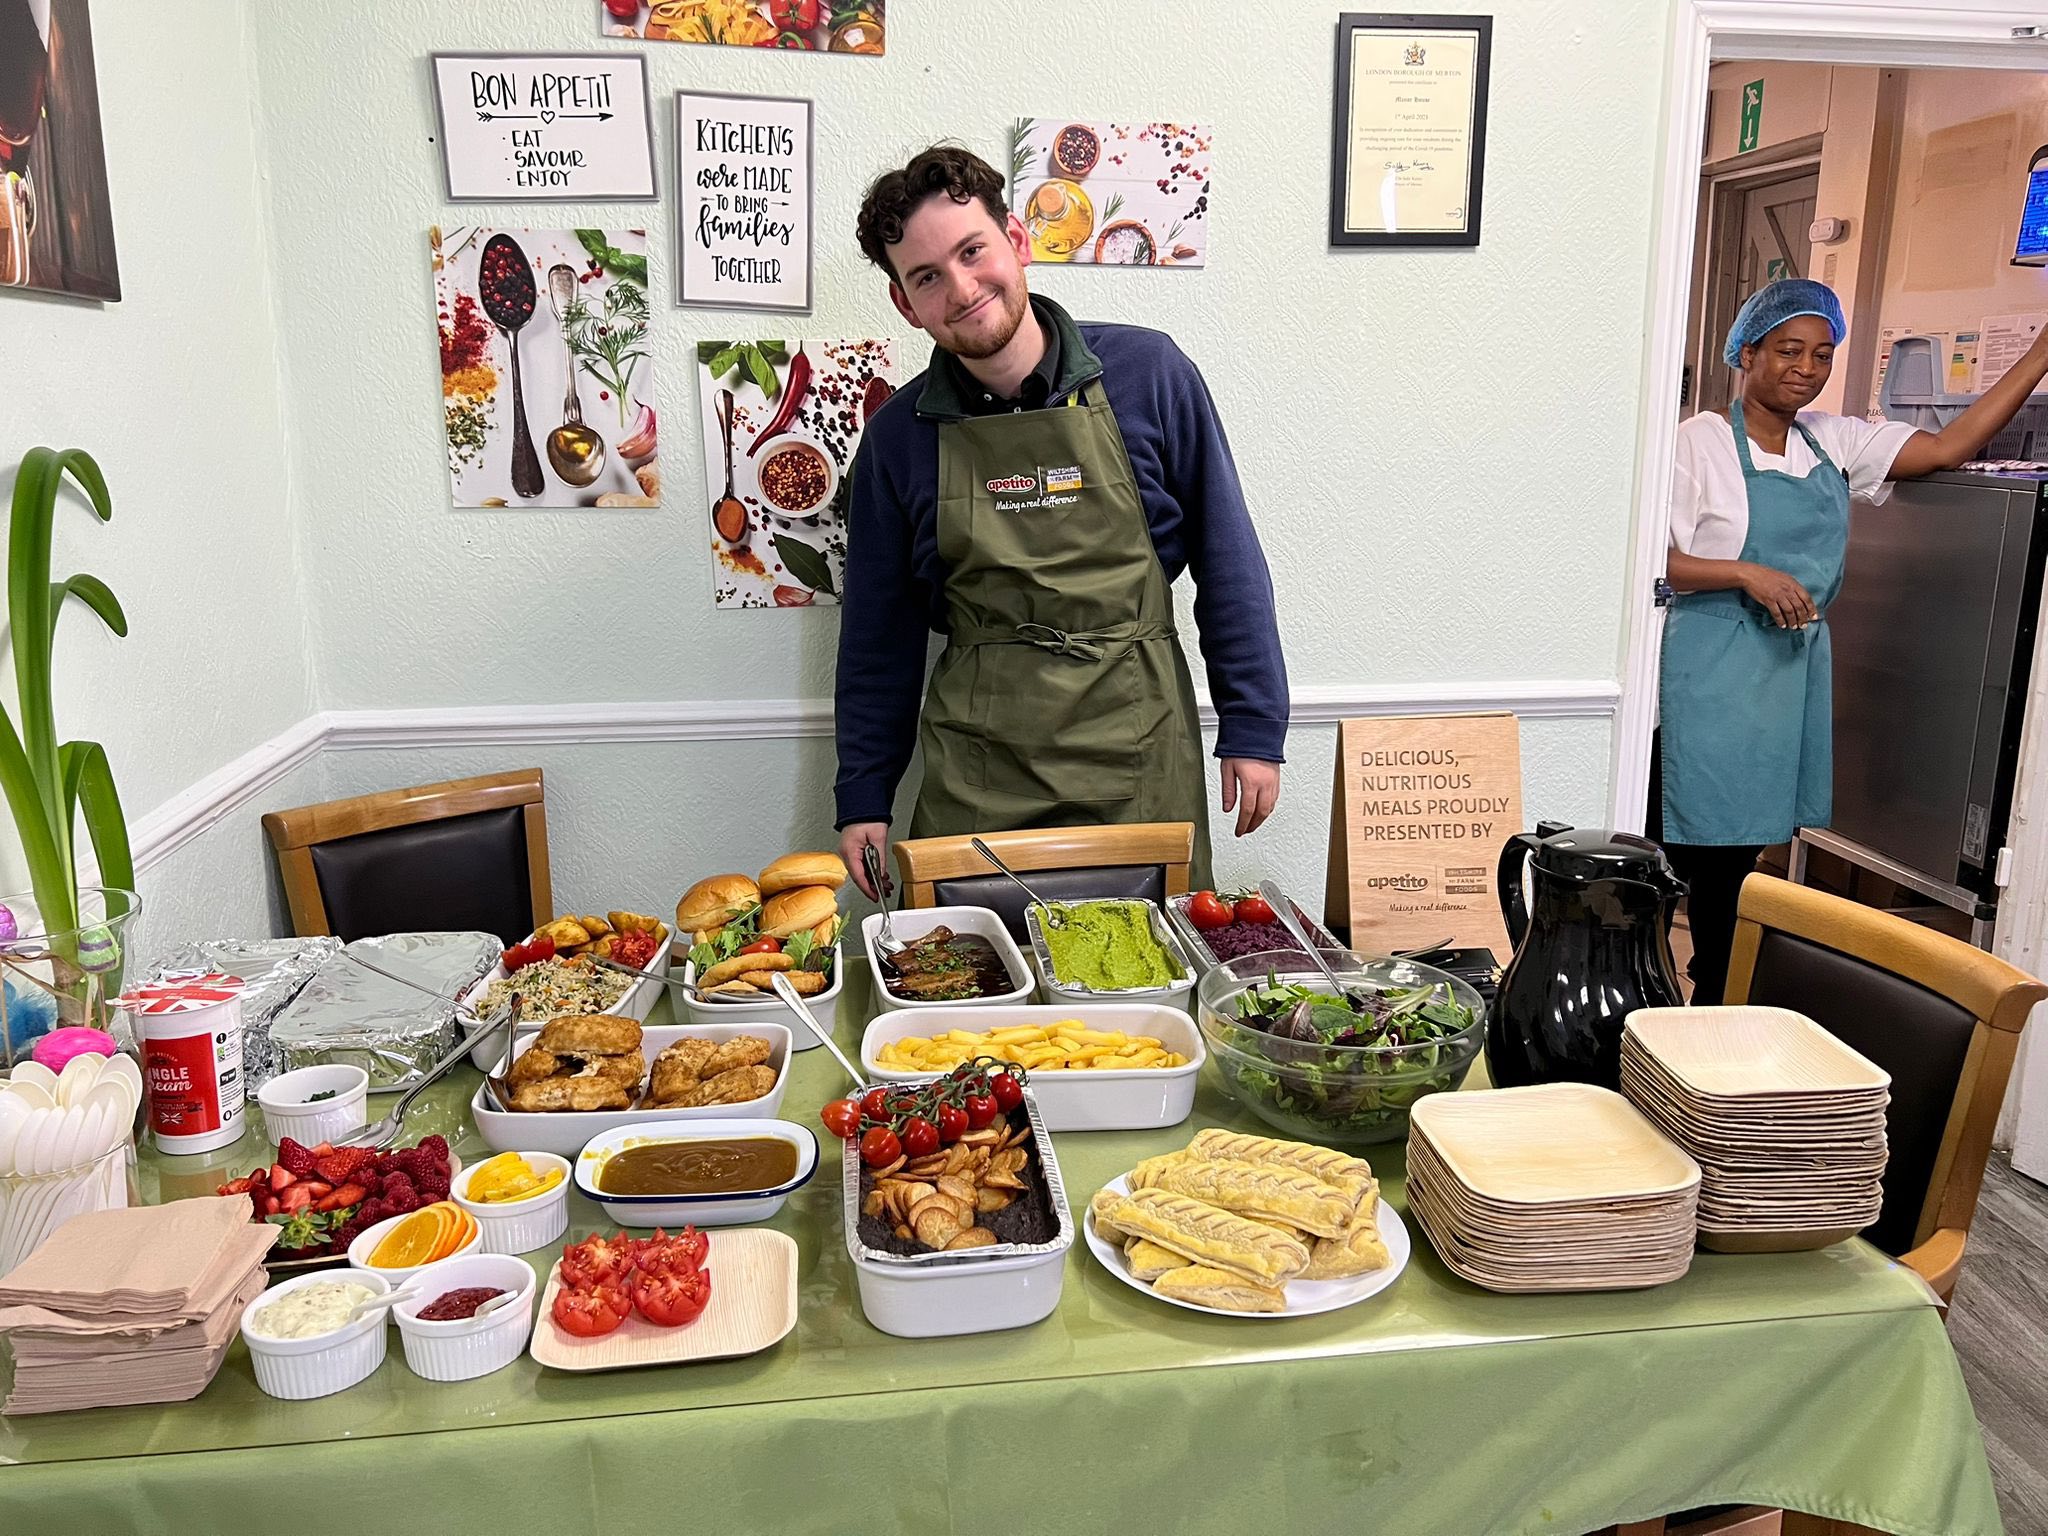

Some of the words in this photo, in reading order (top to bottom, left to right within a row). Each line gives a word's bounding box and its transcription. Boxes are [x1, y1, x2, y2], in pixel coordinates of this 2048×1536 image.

[471, 71, 517, 110] BON
[530, 73, 612, 108] APPETIT
[512, 130, 543, 147] EAT
[696, 118, 793, 156] KITCHENS
[514, 150, 587, 168] SAVOUR
[517, 170, 571, 187] ENJOY
[697, 163, 739, 189] were
[743, 166, 793, 194] MADE
[716, 194, 729, 211] TO
[734, 195, 768, 213] BRING
[695, 203, 795, 249] families
[711, 255, 782, 284] TOGETHER
[987, 475, 1034, 492] apetito
[995, 500, 1020, 513] Making
[1026, 498, 1040, 507] real
[1041, 495, 1079, 508] difference
[1361, 750, 1460, 768] DELICIOUS,
[1362, 774, 1472, 791] NUTRITIOUS
[1363, 799, 1422, 816] MEALS
[1427, 797, 1510, 815] PROUDLY
[1364, 823, 1466, 841] PRESENTED
[1471, 822, 1493, 838] BY
[1367, 873, 1429, 890] apetito
[1389, 903, 1414, 915] Making
[1420, 902, 1434, 911] real
[1435, 902, 1468, 912] difference
